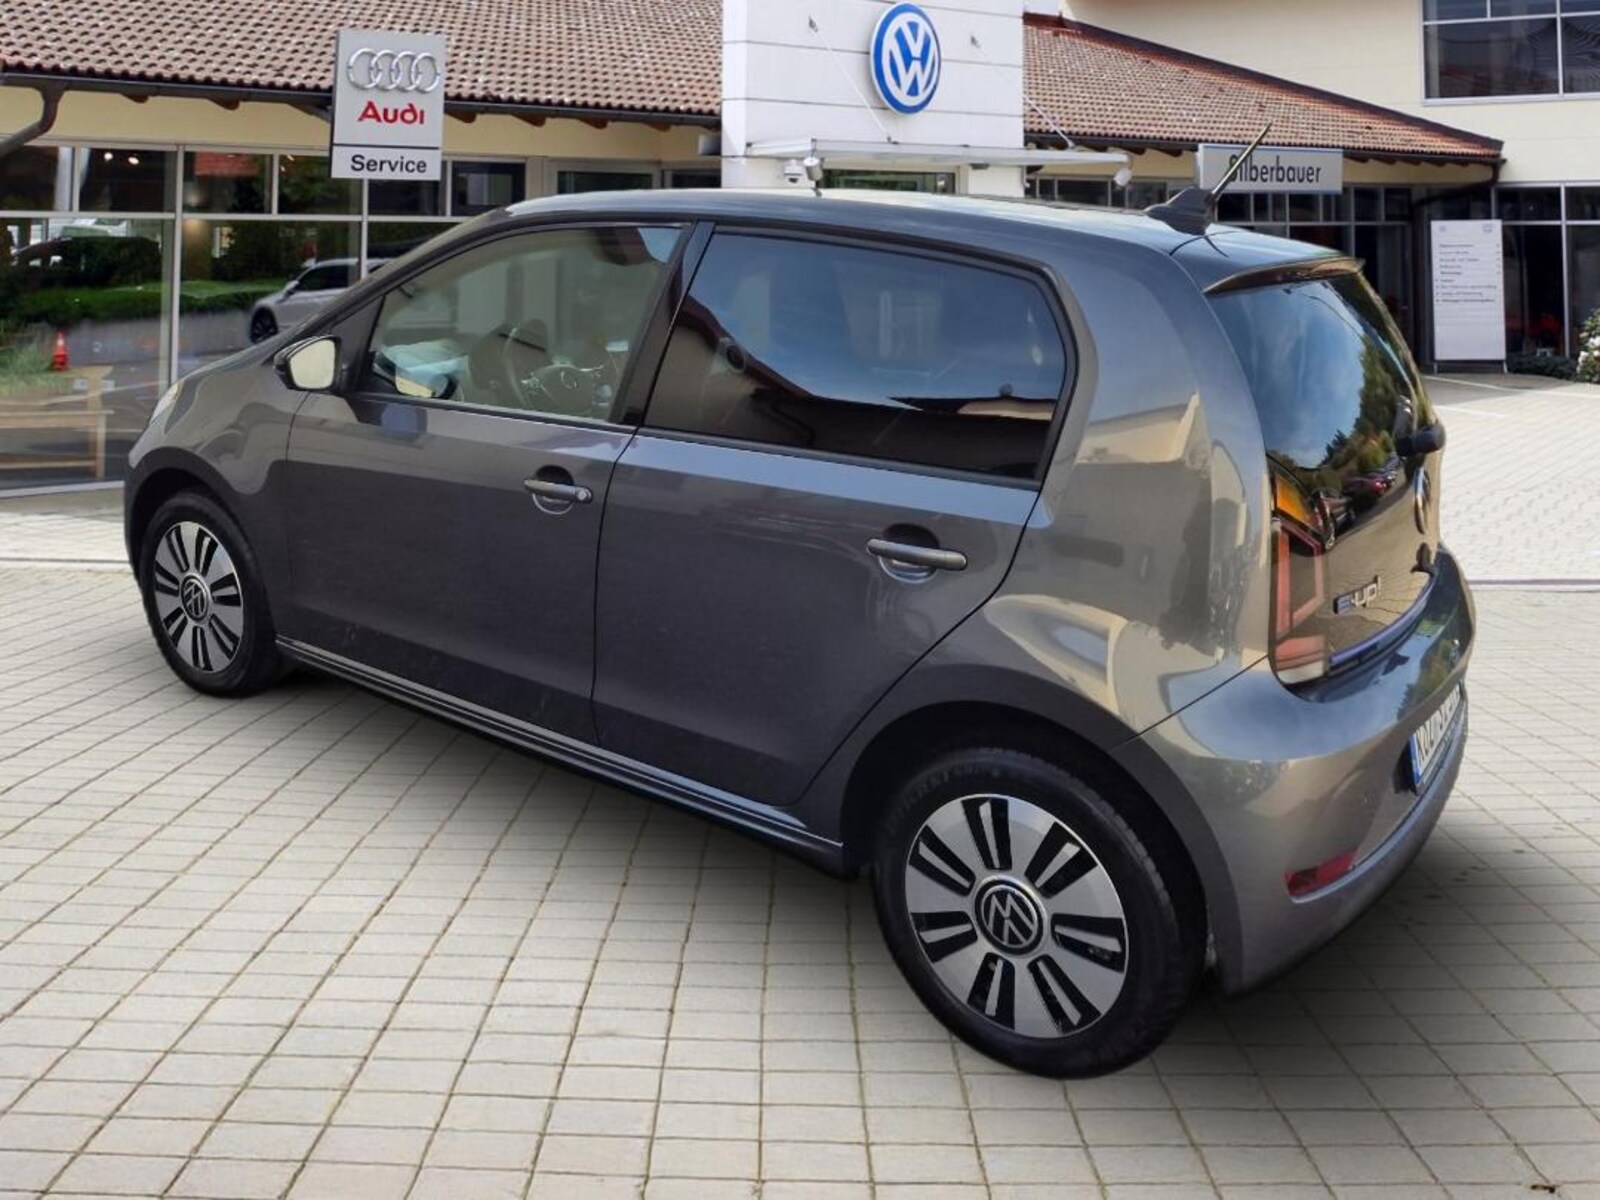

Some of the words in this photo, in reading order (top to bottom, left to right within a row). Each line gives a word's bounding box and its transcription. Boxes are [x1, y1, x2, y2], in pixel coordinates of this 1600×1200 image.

[879, 10, 939, 107] VW
[358, 101, 425, 125] Audi
[351, 154, 428, 174] Service
